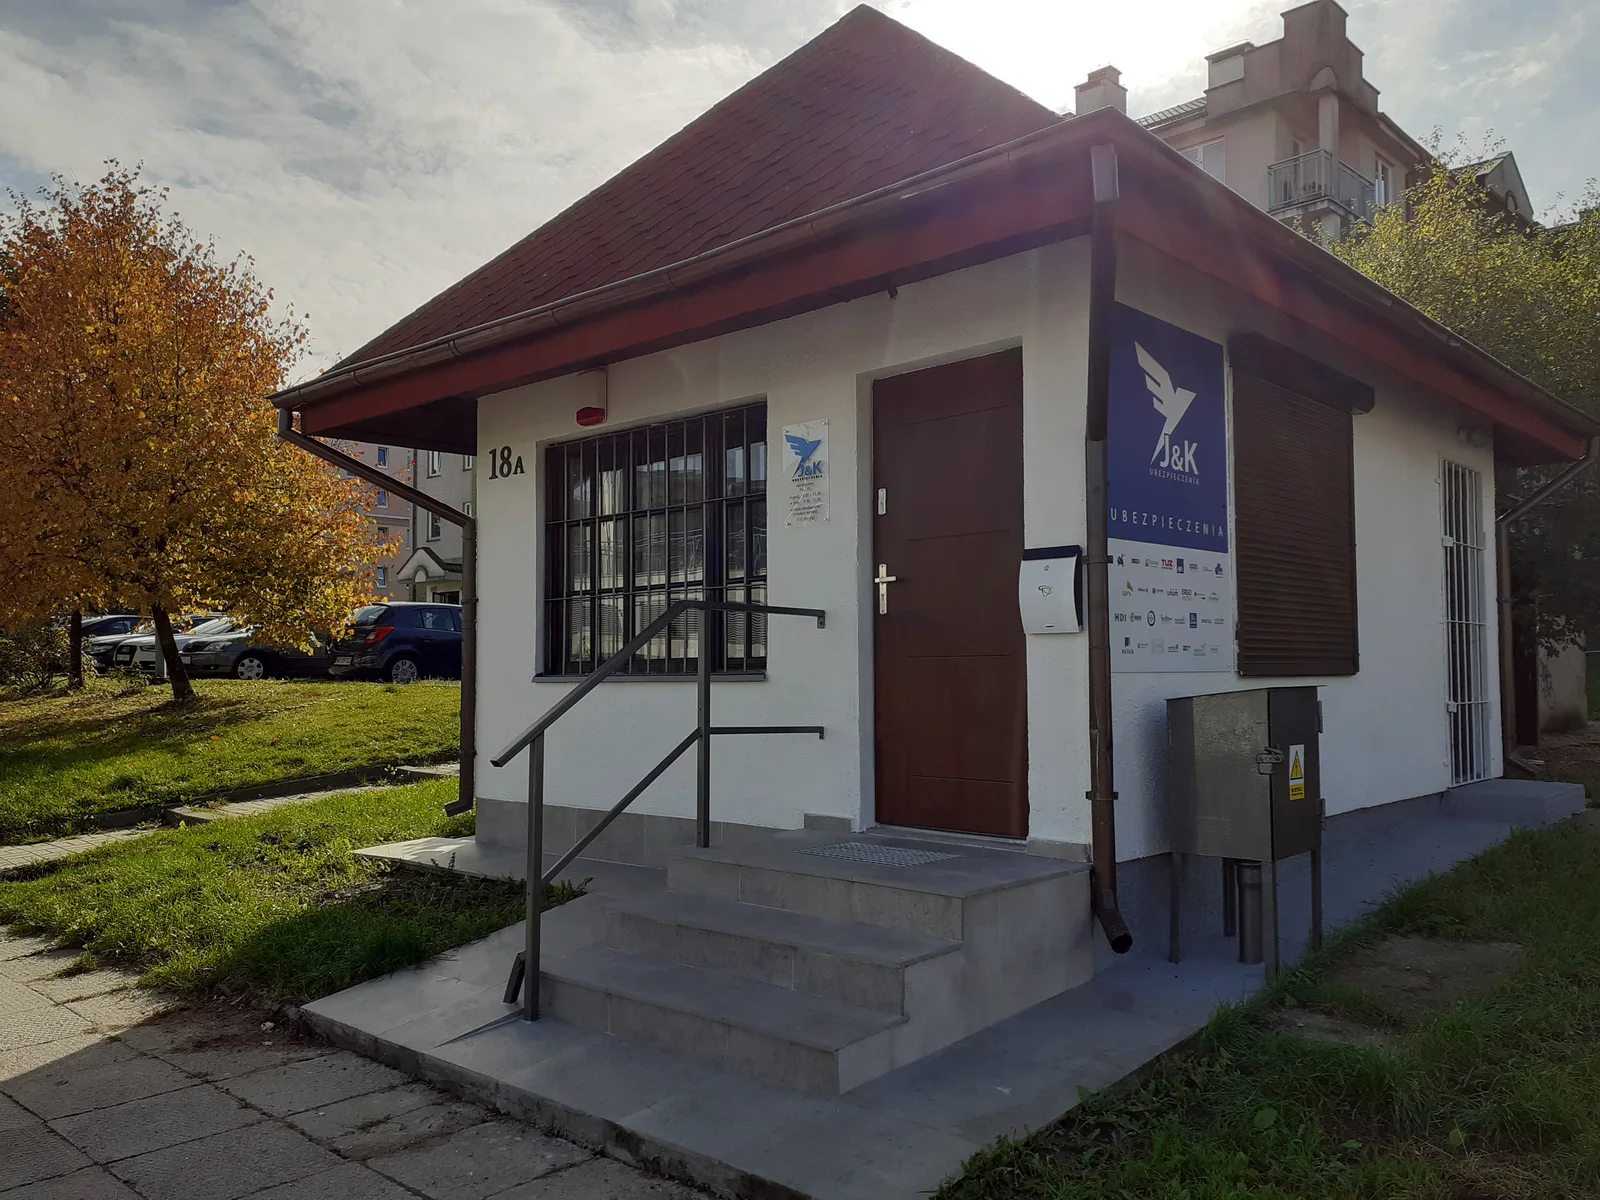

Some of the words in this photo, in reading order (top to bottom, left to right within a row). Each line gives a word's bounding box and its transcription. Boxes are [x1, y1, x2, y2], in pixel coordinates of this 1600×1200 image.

[489, 446, 525, 480] 18A
[1160, 434, 1198, 475] J&K
[798, 461, 822, 477] J&K
[1149, 468, 1199, 485] UBEZPIECZENIA
[1110, 508, 1223, 537] UBEZPIECZENIA
[1161, 559, 1173, 567] TUZ
[1114, 613, 1127, 622] HDI
